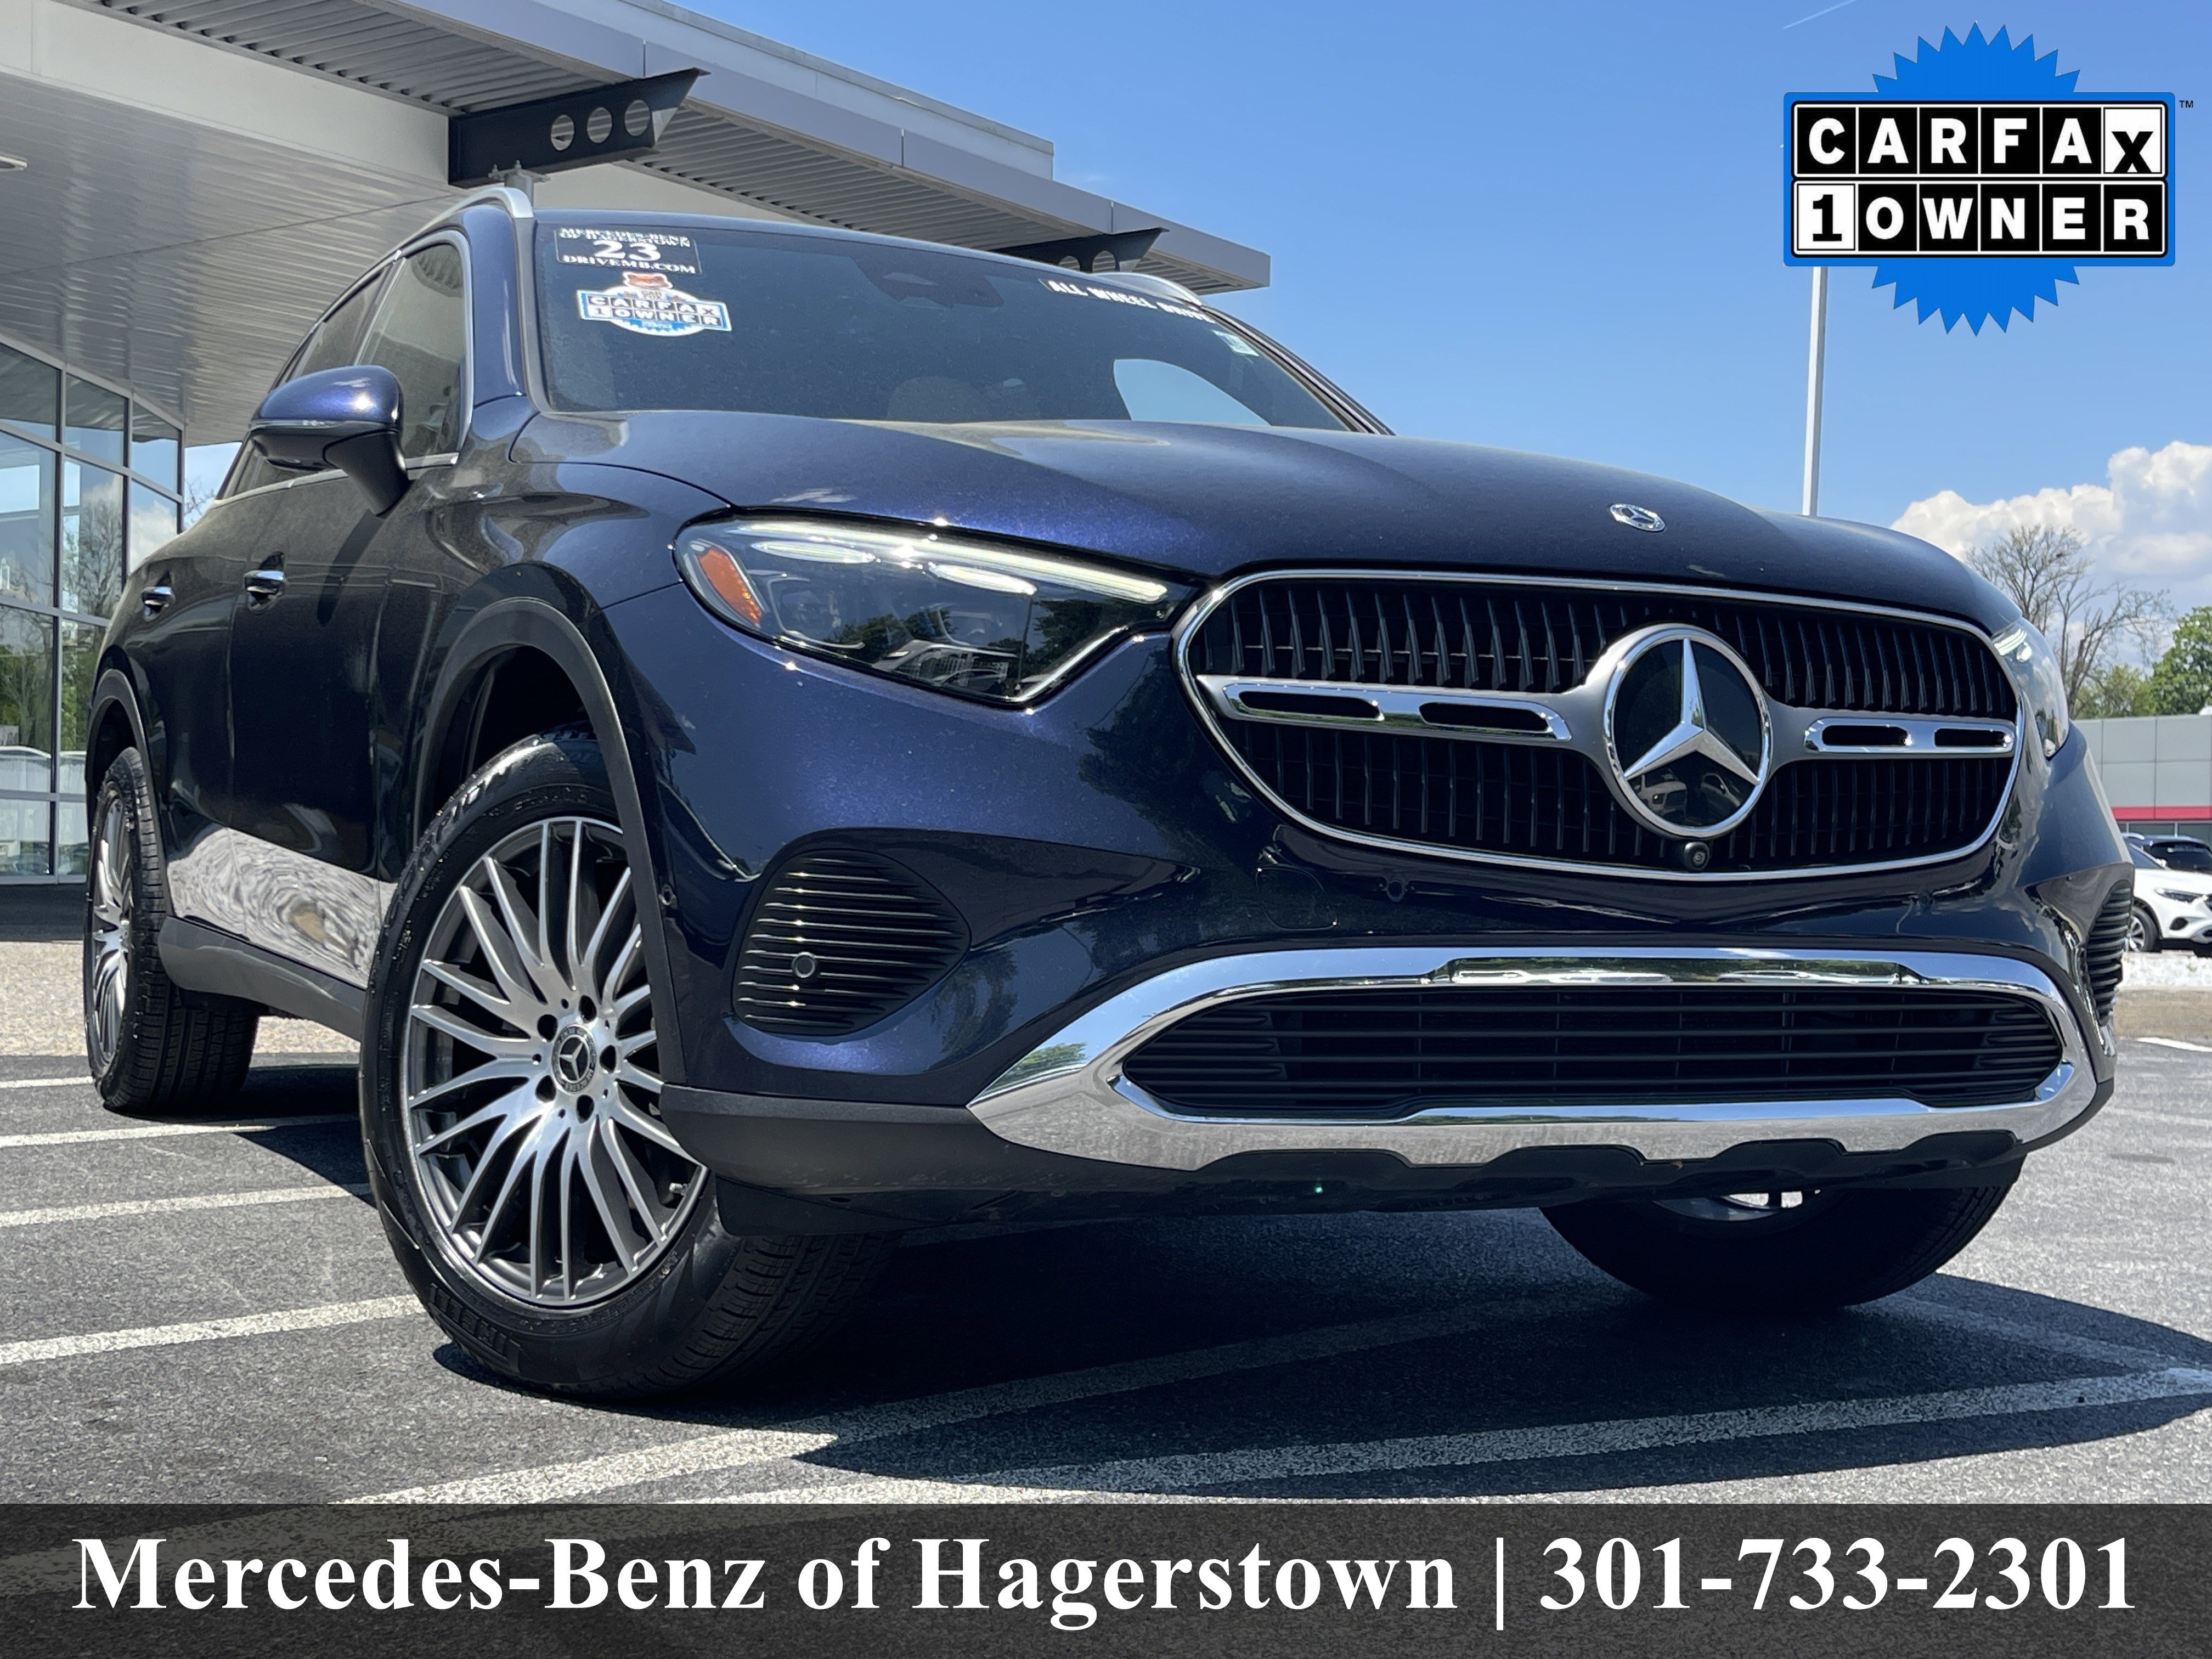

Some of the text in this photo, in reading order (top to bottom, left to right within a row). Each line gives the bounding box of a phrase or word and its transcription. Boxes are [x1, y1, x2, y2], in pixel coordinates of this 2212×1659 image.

[593, 240, 662, 262] 23
[1048, 280, 1089, 296] ALL
[589, 296, 714, 315] CARFAX
